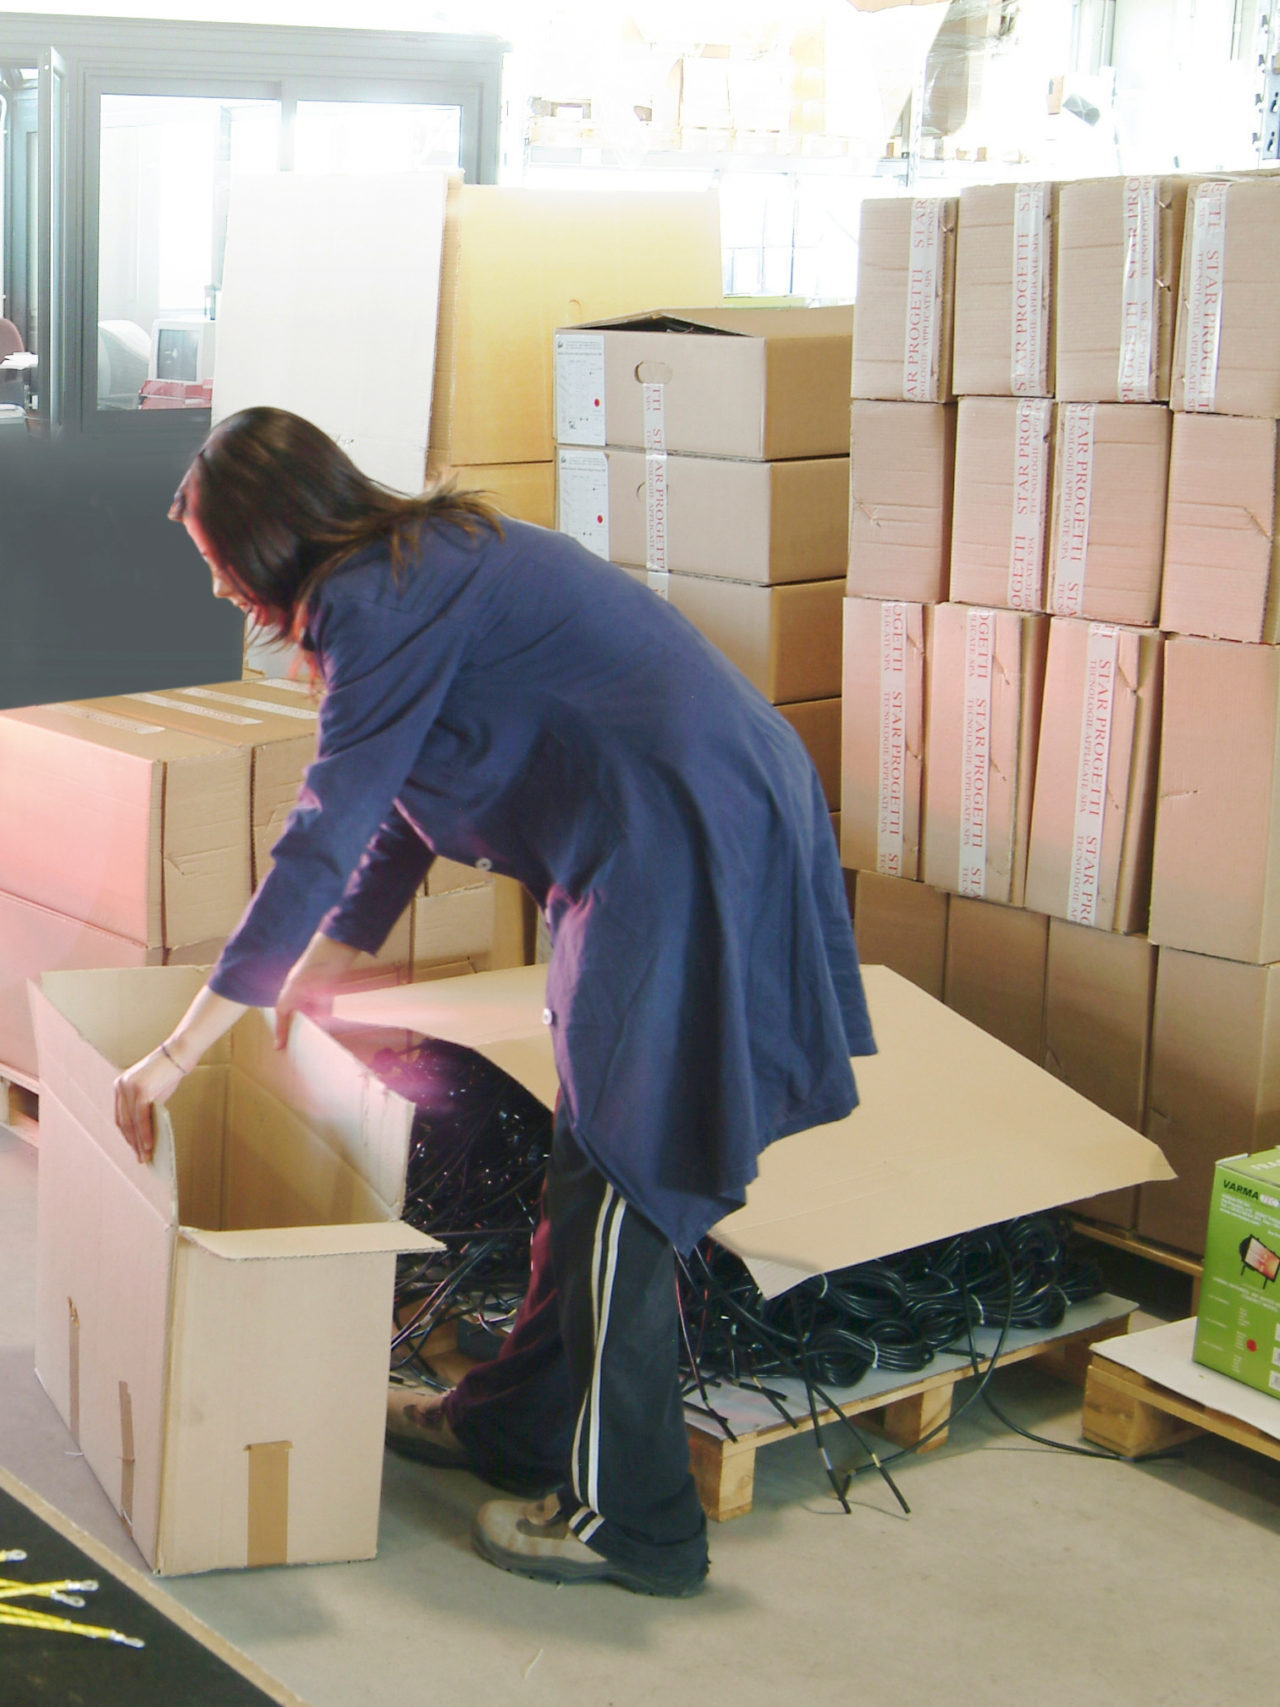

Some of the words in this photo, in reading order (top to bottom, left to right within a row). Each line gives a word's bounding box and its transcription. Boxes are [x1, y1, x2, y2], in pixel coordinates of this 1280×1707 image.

[913, 200, 928, 248] STAR
[1015, 233, 1029, 334] PROGETTI
[1204, 250, 1219, 306] STAR
[908, 269, 923, 365] PROGETTI
[1015, 340, 1027, 392] STAR
[1076, 404, 1093, 454] STAR
[1017, 465, 1030, 515] STAR
[1070, 461, 1089, 561] PROGETTI
[1096, 659, 1111, 709] STAR
[892, 690, 903, 740] STAR
[975, 698, 987, 746] STAR
[889, 744, 903, 836] PROGETTI
[1088, 717, 1107, 815] PROGETTI
[971, 753, 985, 847] PROGETTI
[1082, 836, 1098, 885] STAR
[1223, 1179, 1260, 1200] VARMA
